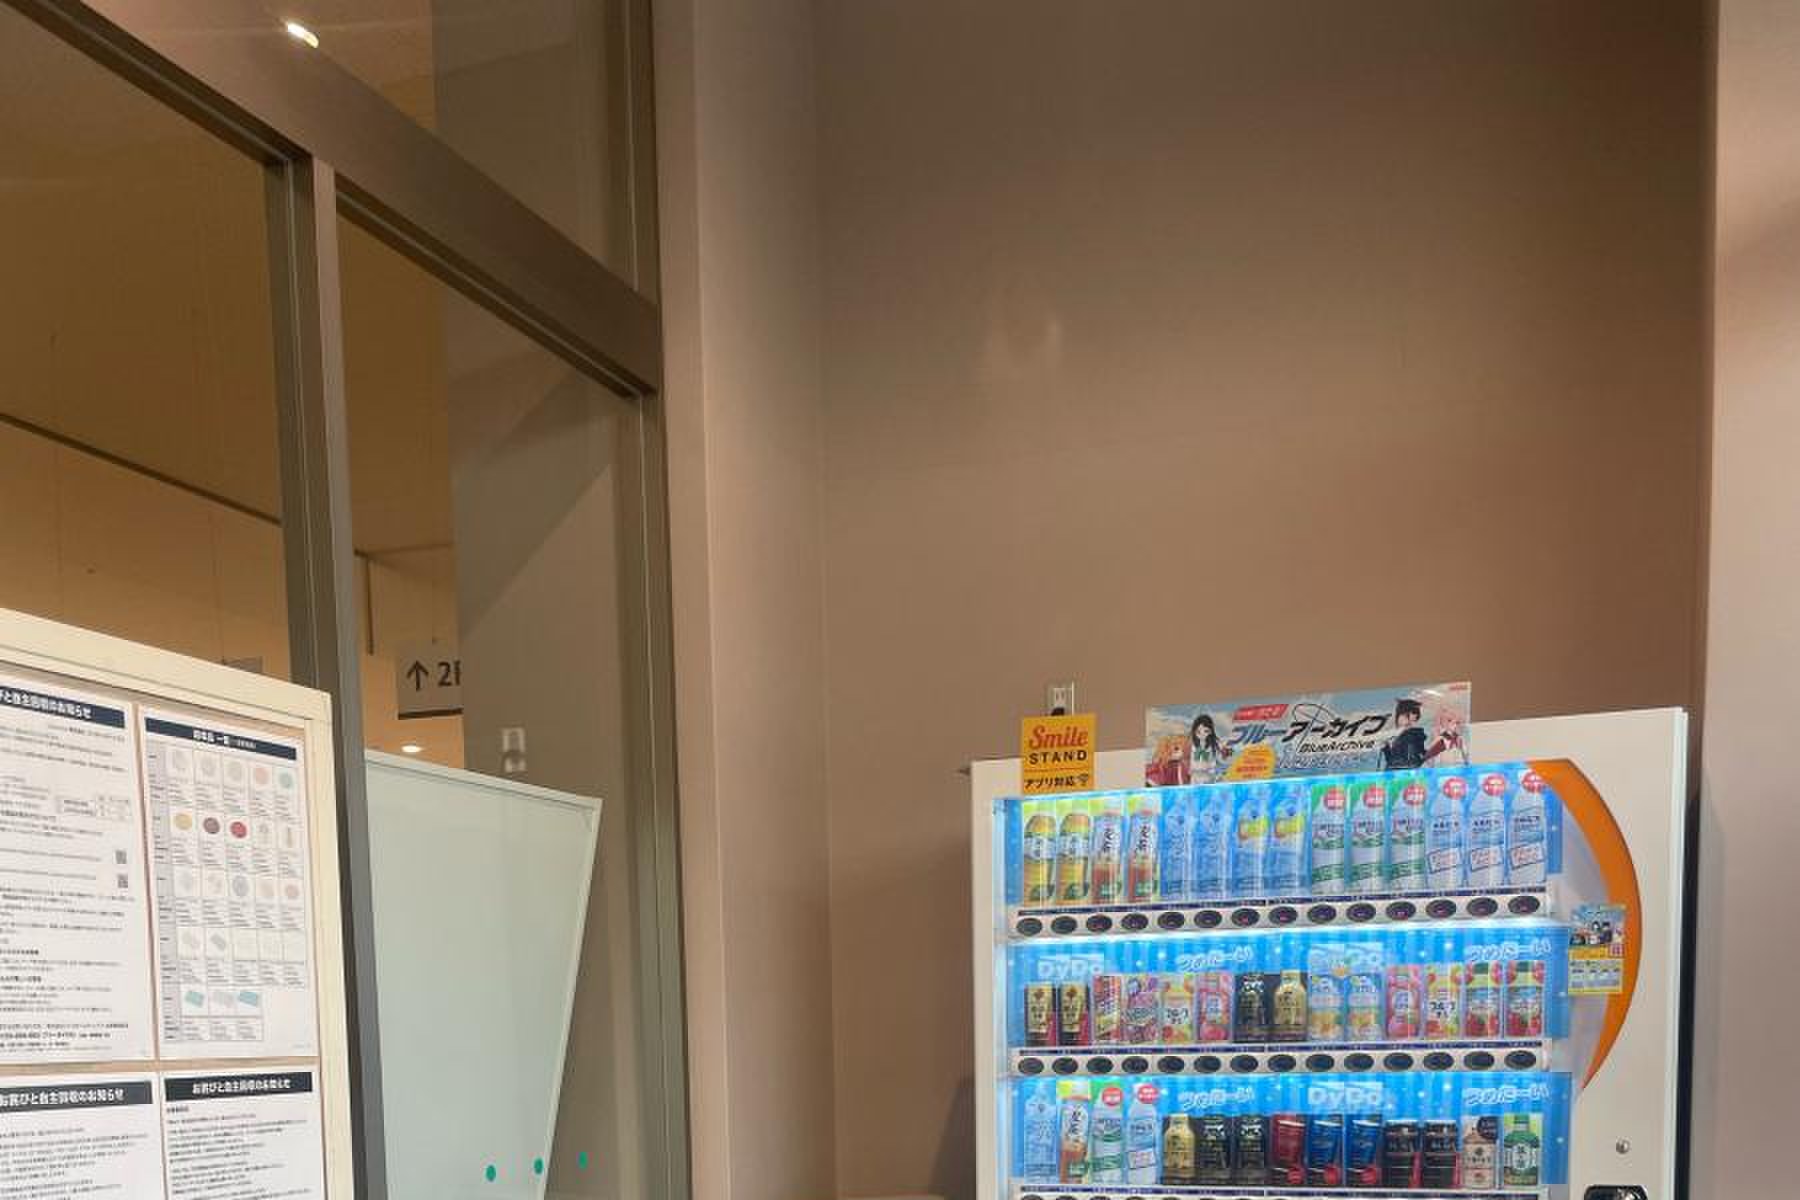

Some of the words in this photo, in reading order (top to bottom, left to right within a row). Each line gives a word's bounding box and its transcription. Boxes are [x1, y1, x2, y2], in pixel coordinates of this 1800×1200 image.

[1029, 725, 1088, 749] Smile
[1029, 750, 1087, 764] STAND
[1024, 776, 1074, 789] アプリ対応
